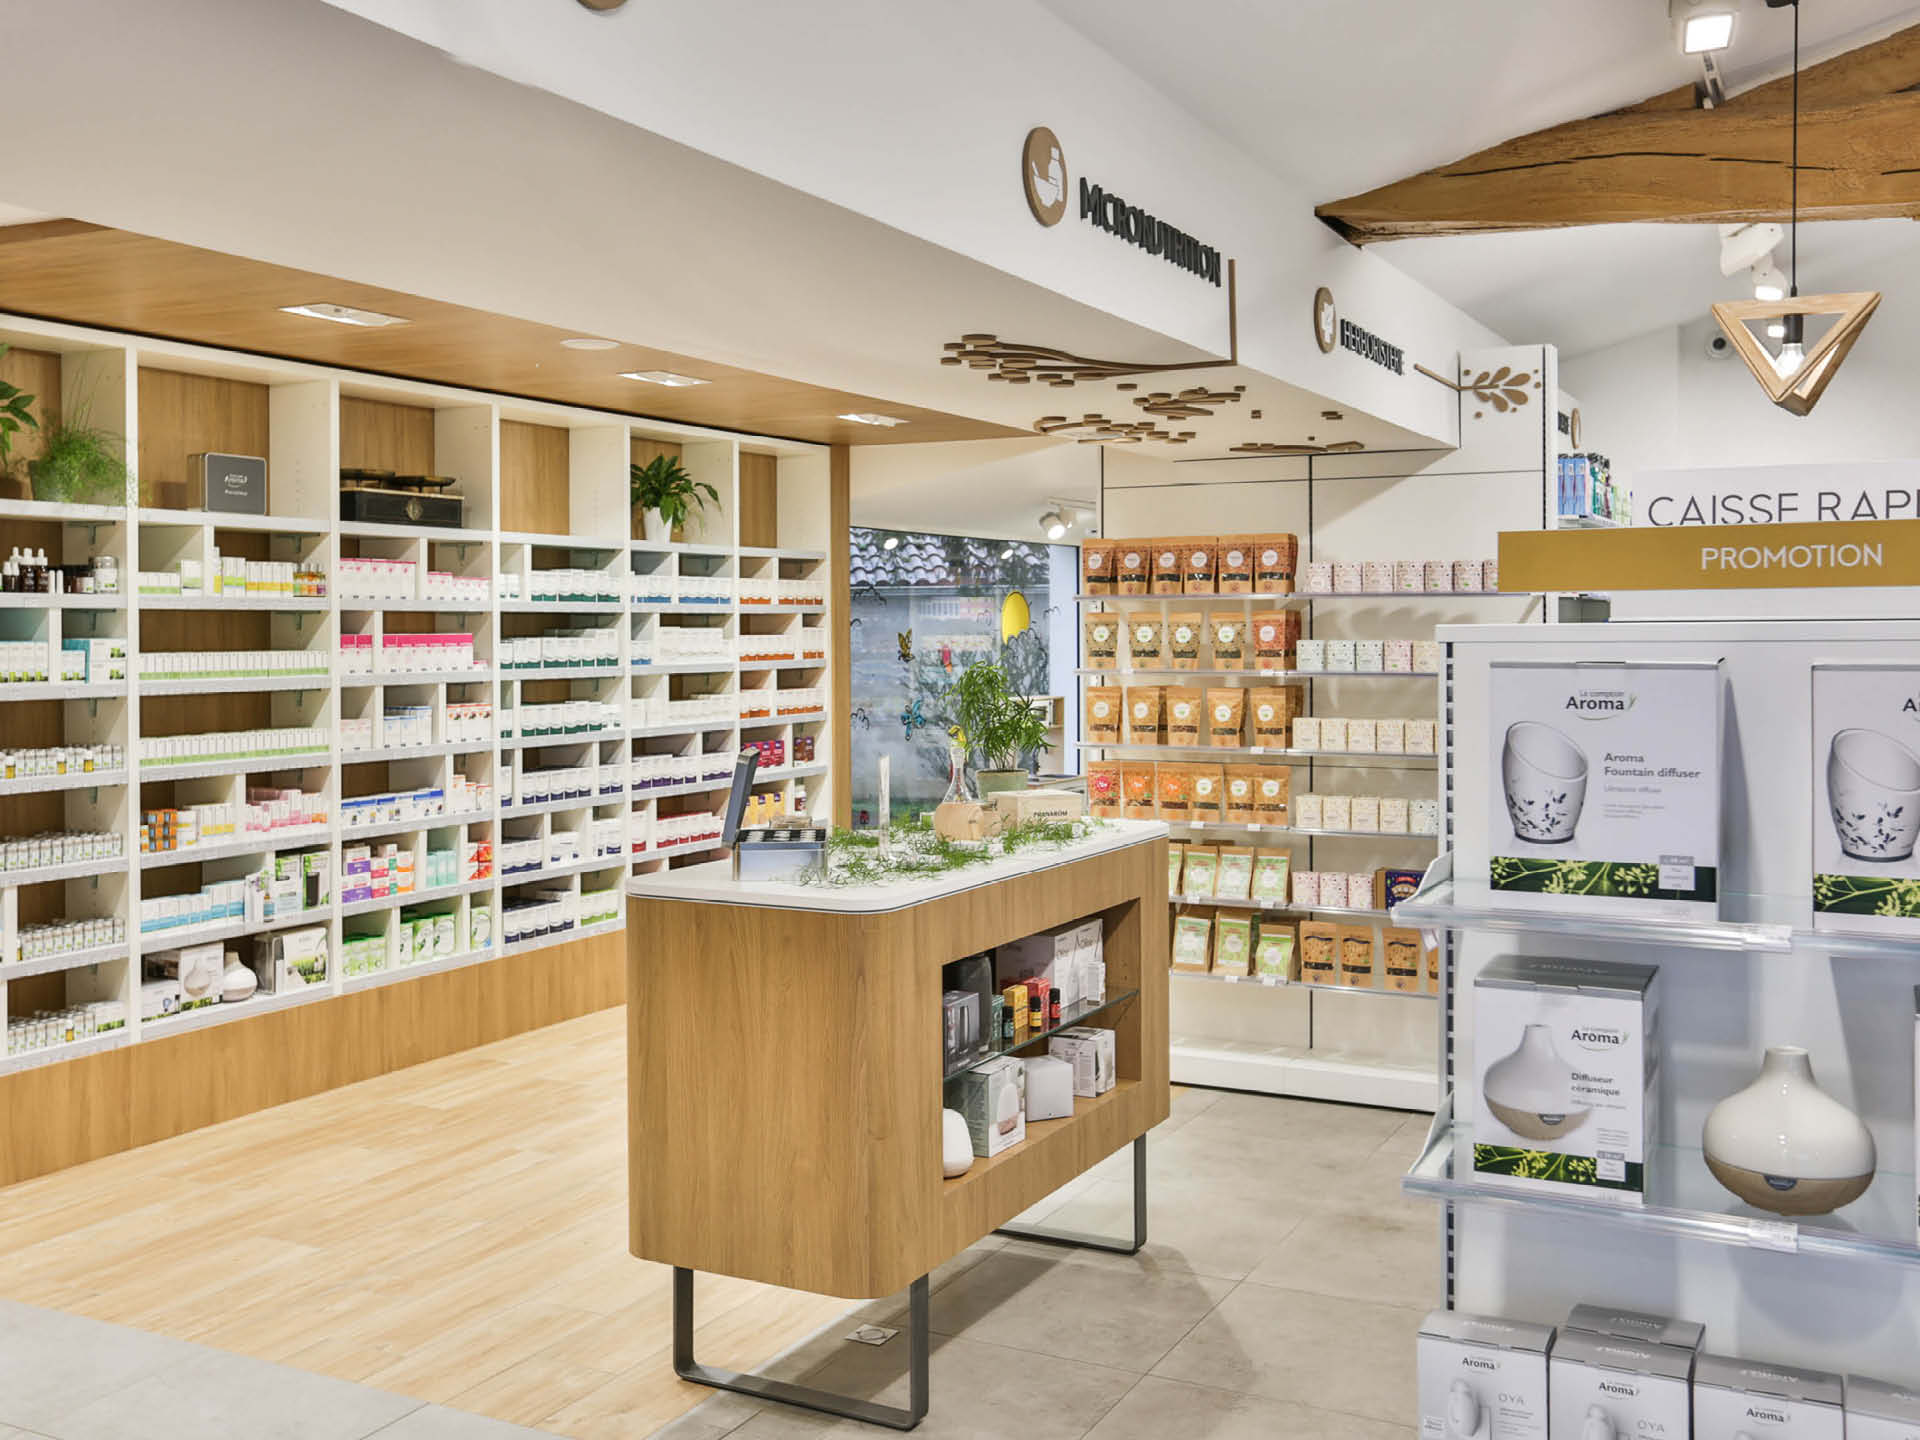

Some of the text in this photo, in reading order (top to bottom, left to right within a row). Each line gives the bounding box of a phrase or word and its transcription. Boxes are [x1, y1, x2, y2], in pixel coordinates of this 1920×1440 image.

[1080, 177, 1221, 288] MICRONUTRITION
[1701, 543, 1884, 571] PROMOTION
[1566, 696, 1624, 710] Aroma
[1604, 753, 1644, 762] Aroma
[1604, 766, 1701, 778] Fountain diffuser
[1571, 1029, 1619, 1044] Aroma
[1571, 1072, 1614, 1083] Diffuseur
[1462, 1357, 1495, 1370] Aroma
[1599, 1382, 1634, 1396] Aroma
[1746, 1407, 1785, 1422] Aroma
